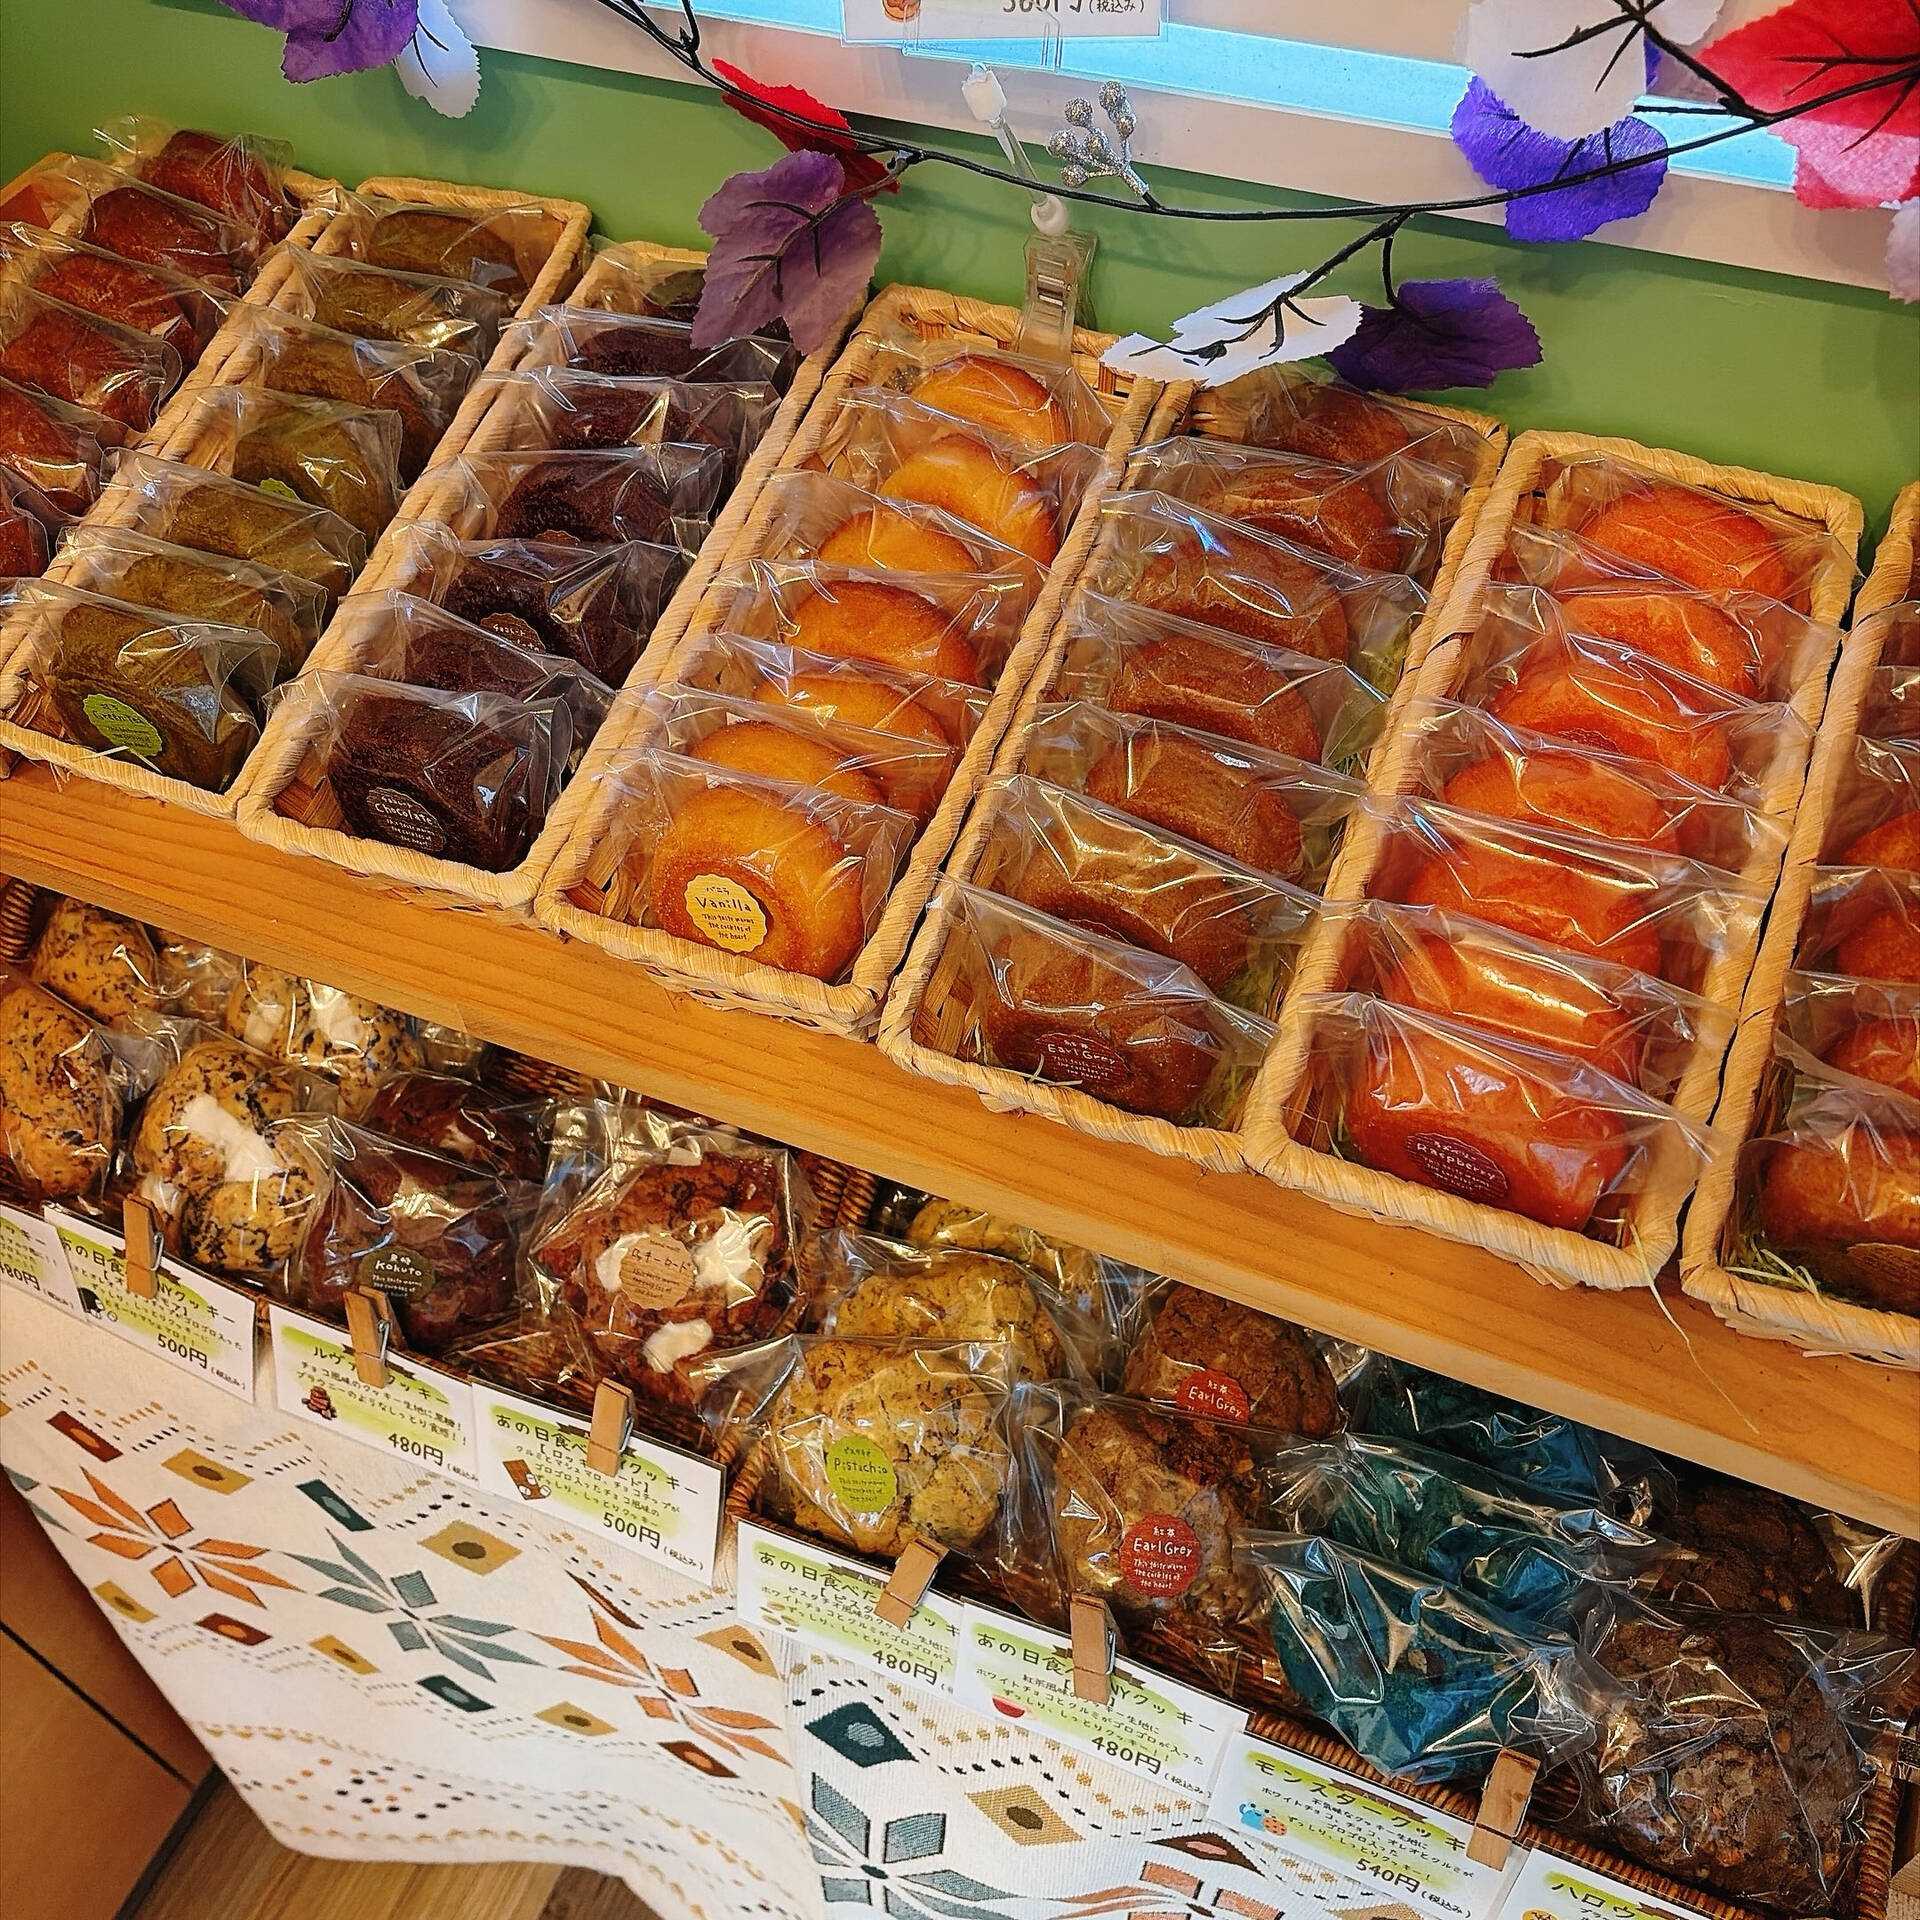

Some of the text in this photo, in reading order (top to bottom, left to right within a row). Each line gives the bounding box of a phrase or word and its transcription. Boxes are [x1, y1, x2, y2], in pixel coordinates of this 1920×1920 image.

[375, 803, 433, 825] Chocolate
[695, 896, 752, 912] Vanilla
[706, 886, 730, 895] バニラ
[1047, 1043, 1116, 1065] Earl Grey
[1417, 1143, 1496, 1181] Raspberry
[375, 1260, 423, 1277] Kokuto
[156, 1331, 207, 1369] 500円
[1188, 1386, 1214, 1404] Earl
[1216, 1398, 1242, 1418] Grey
[388, 1428, 443, 1467] 480円
[834, 1457, 888, 1474] Pistachio
[603, 1511, 703, 1570] 500円 (税込み)
[1133, 1537, 1193, 1557] Earl Grey
[1153, 1526, 1176, 1538] 紅茶
[872, 1650, 937, 1683] 480円
[1090, 1735, 1212, 1797] 480円 (税込み)
[1326, 1824, 1400, 1855] ゴロゴロ入った
[1355, 1858, 1472, 1918] 540円 (税込み)
